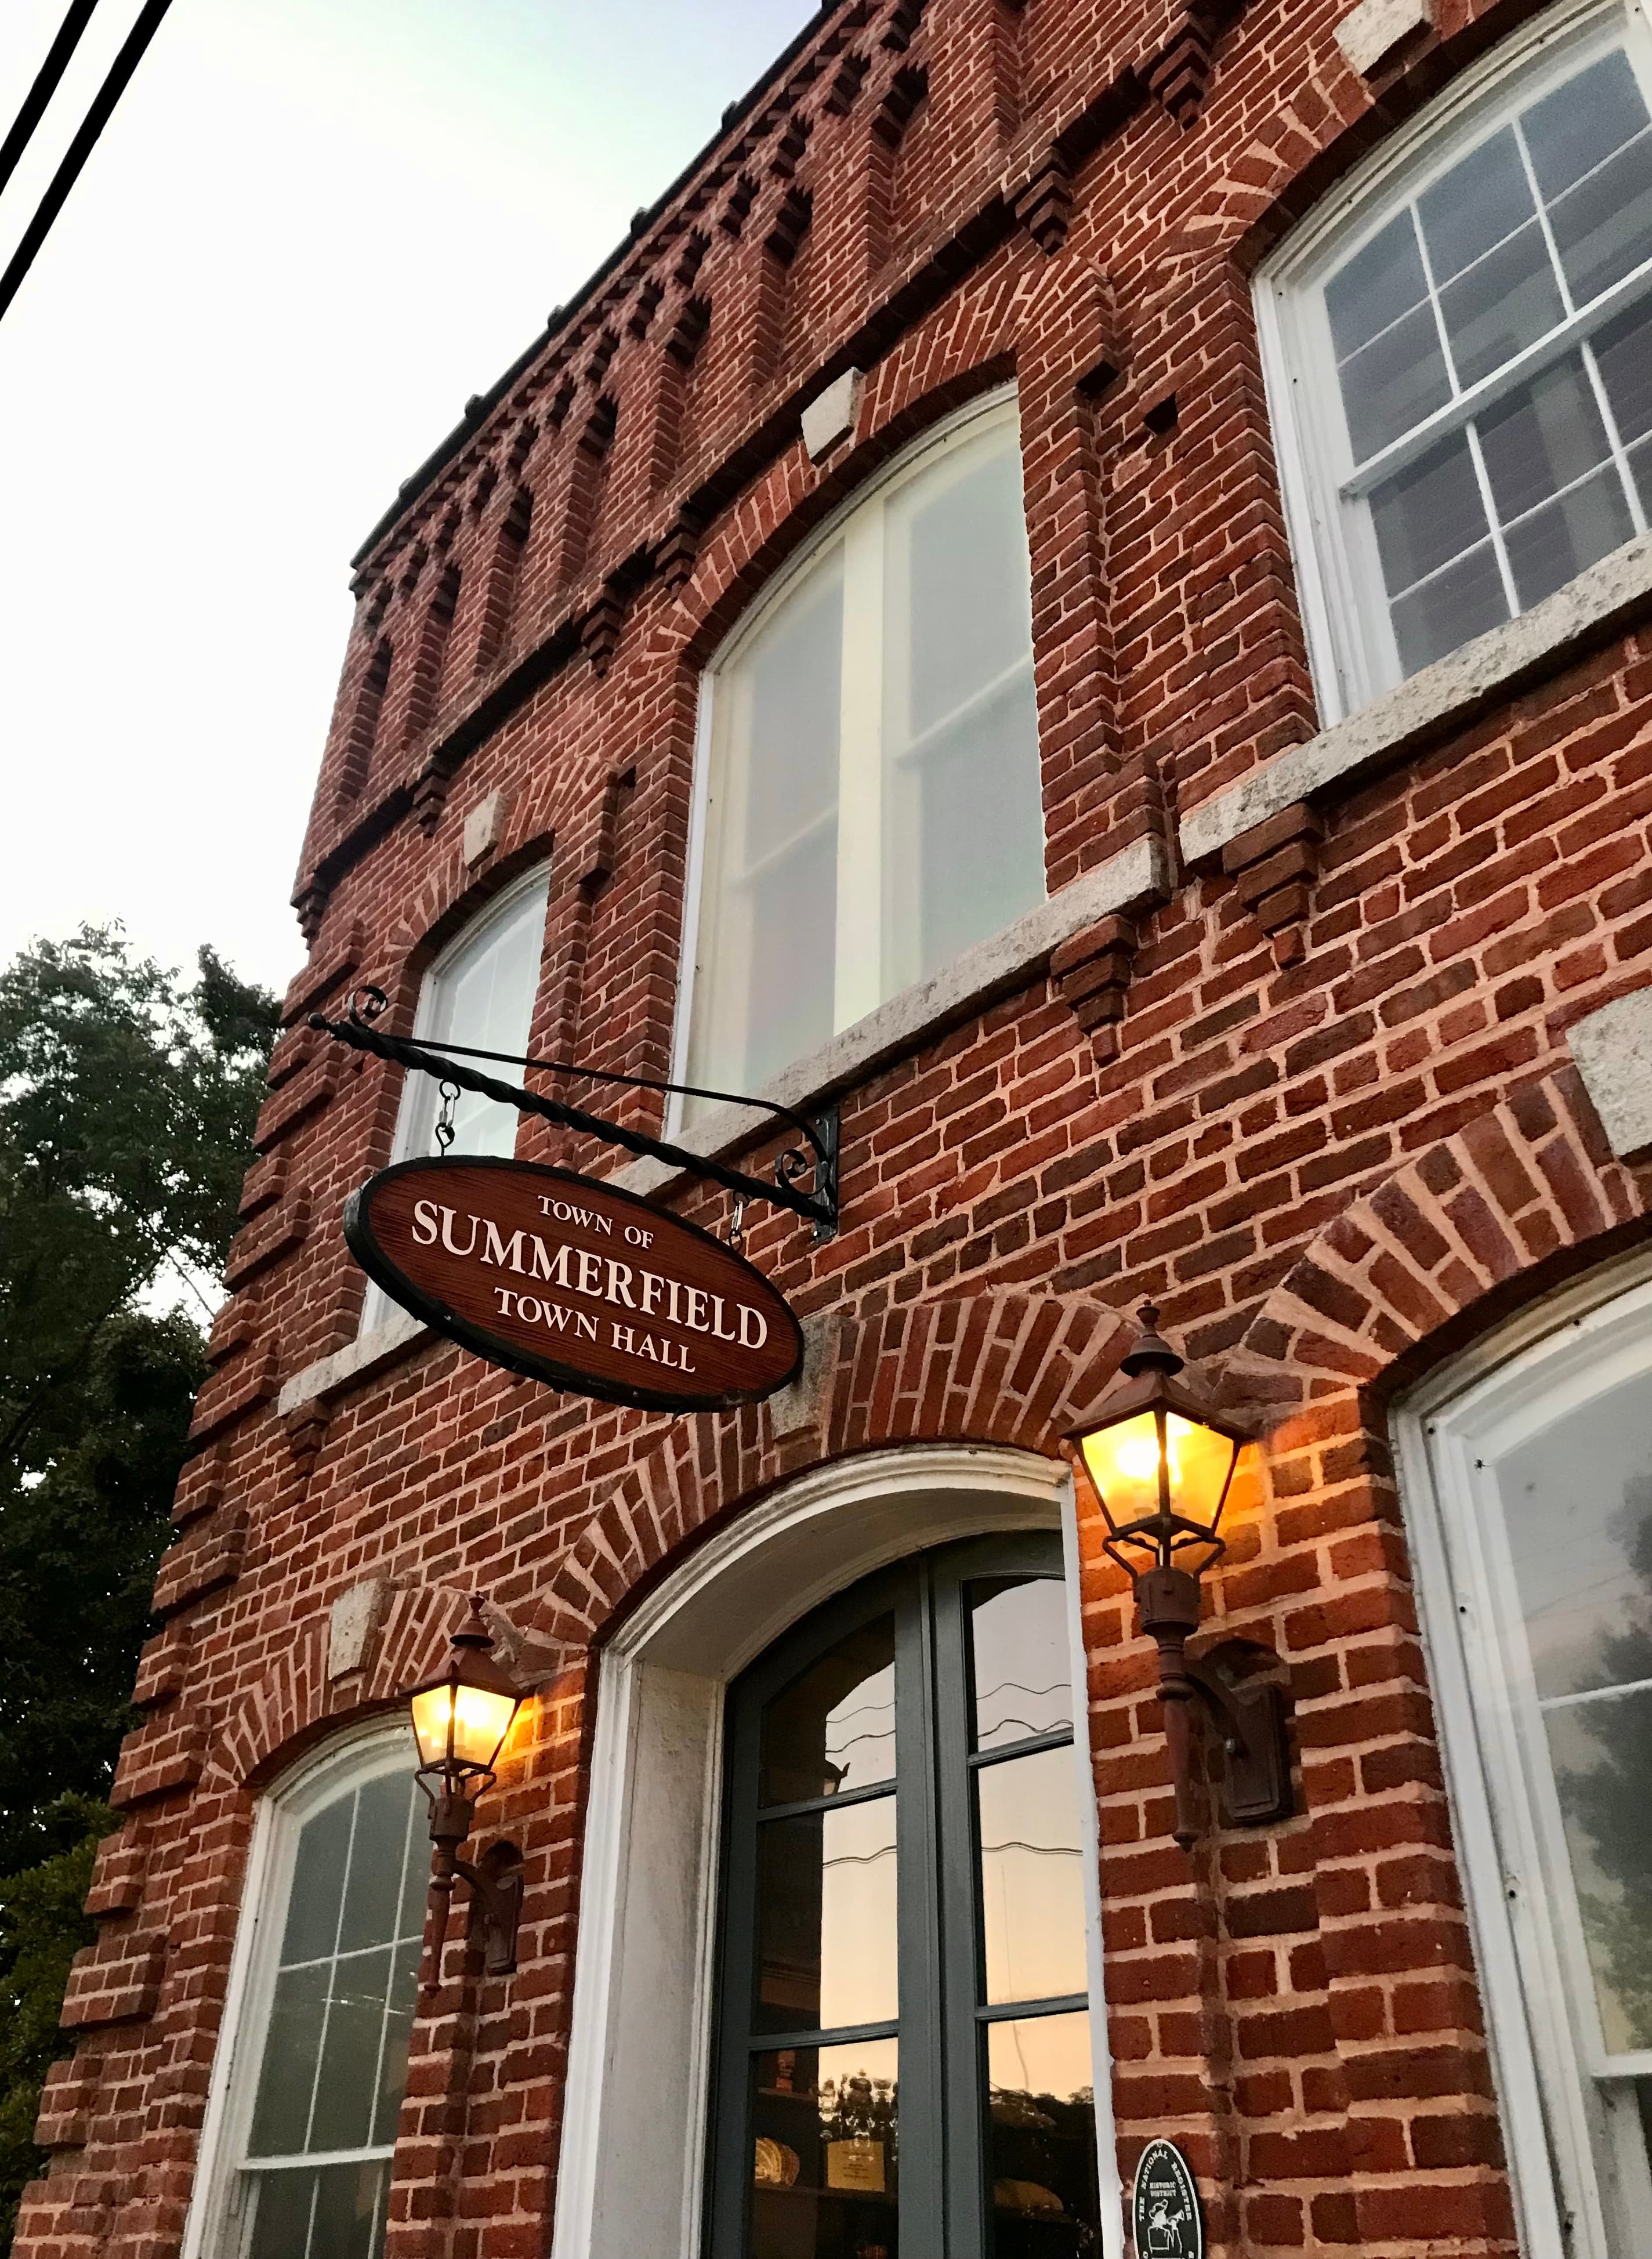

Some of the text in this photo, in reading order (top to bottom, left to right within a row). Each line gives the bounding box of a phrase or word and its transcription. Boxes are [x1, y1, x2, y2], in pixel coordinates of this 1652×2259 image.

[538, 1196, 654, 1248] TOWN OF
[412, 1200, 767, 1349] SUMMERFIELD
[494, 1287, 695, 1373] TOWN HALL
[1141, 2148, 1168, 2190] NATIONAL
